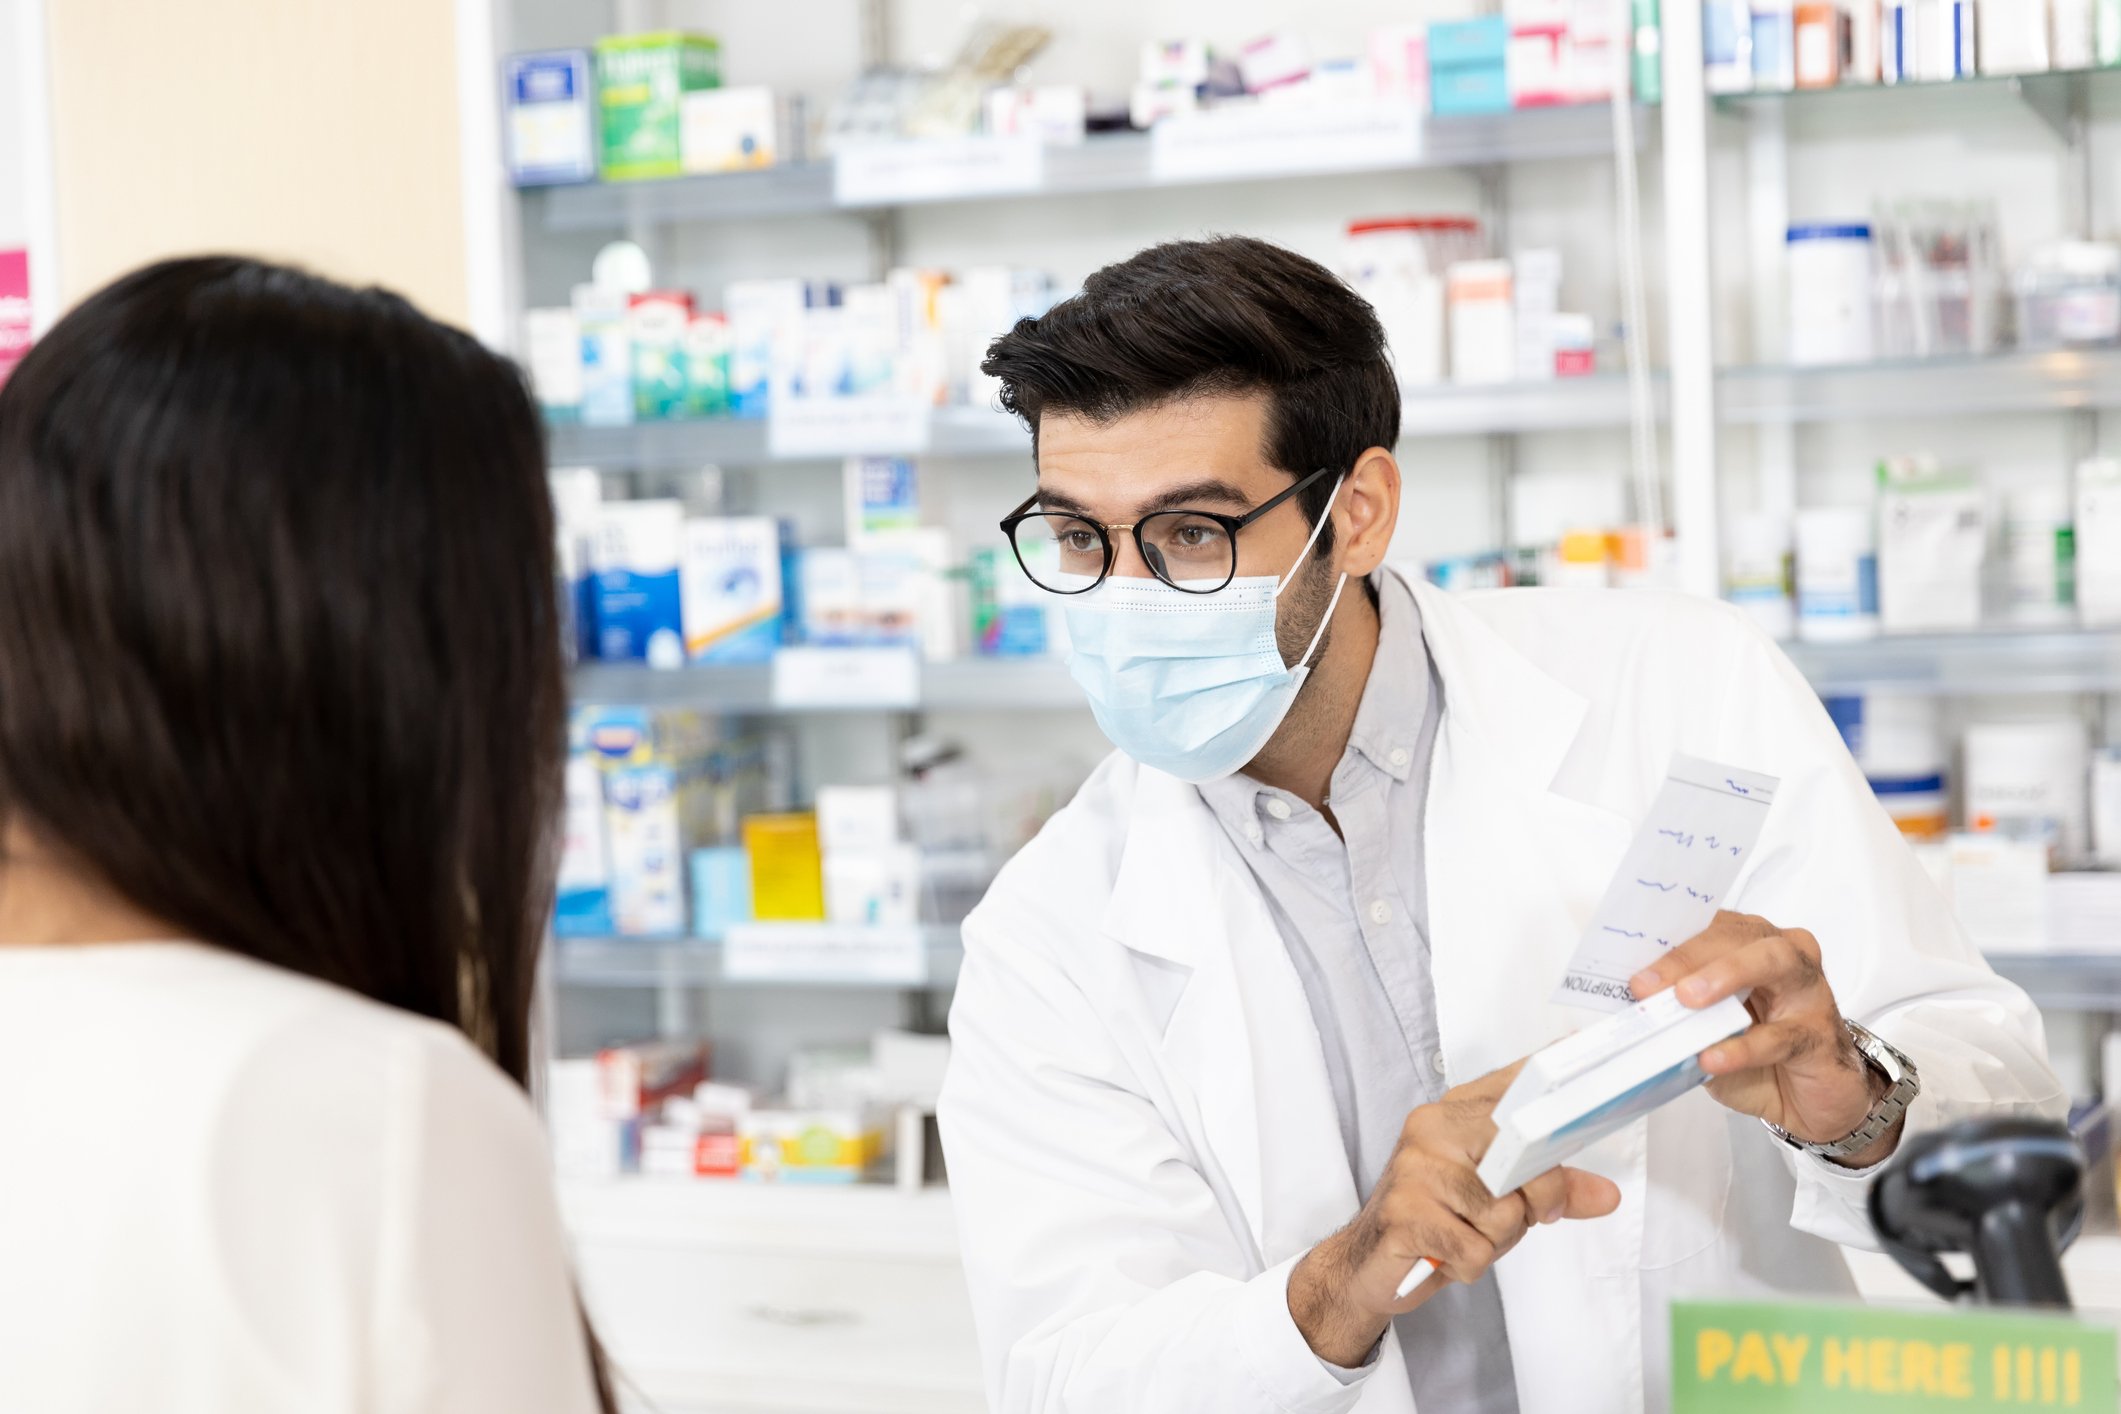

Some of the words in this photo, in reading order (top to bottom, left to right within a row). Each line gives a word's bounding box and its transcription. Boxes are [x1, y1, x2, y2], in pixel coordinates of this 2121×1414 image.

[1562, 976, 1637, 1003] SCRIPTION
[1697, 1328, 1809, 1385] PAY
[1822, 1337, 1974, 1399] HERE
